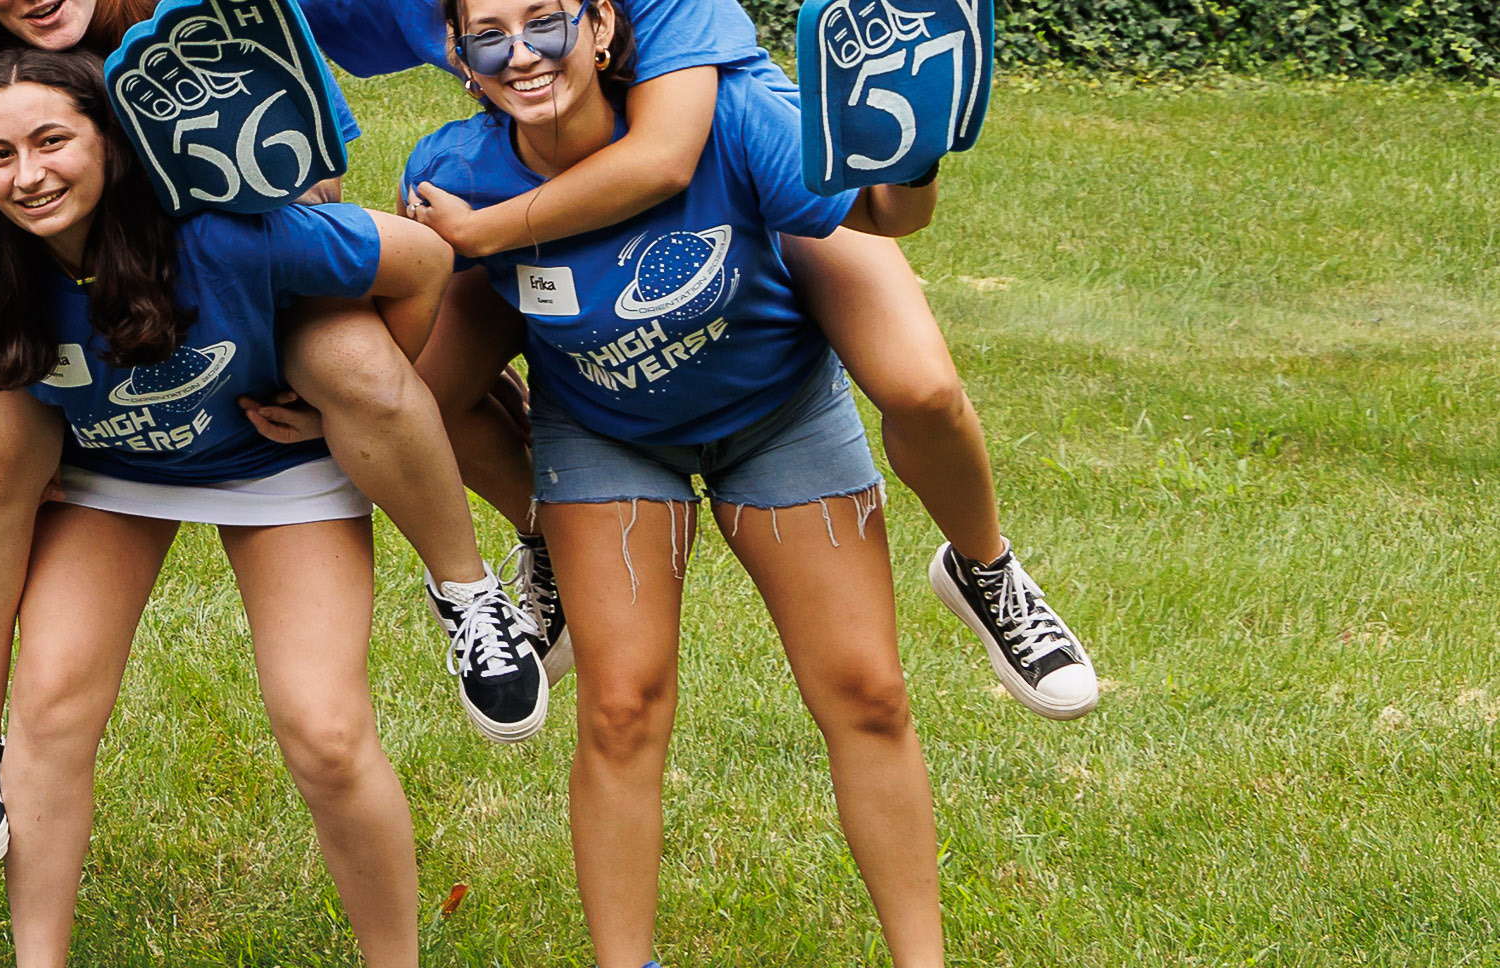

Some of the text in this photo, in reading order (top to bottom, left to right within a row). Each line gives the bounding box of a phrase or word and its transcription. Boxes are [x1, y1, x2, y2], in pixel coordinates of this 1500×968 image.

[846, 30, 966, 170] 57
[172, 89, 313, 202] 56
[585, 319, 669, 367] HIGH
[78, 407, 156, 441] HIGH
